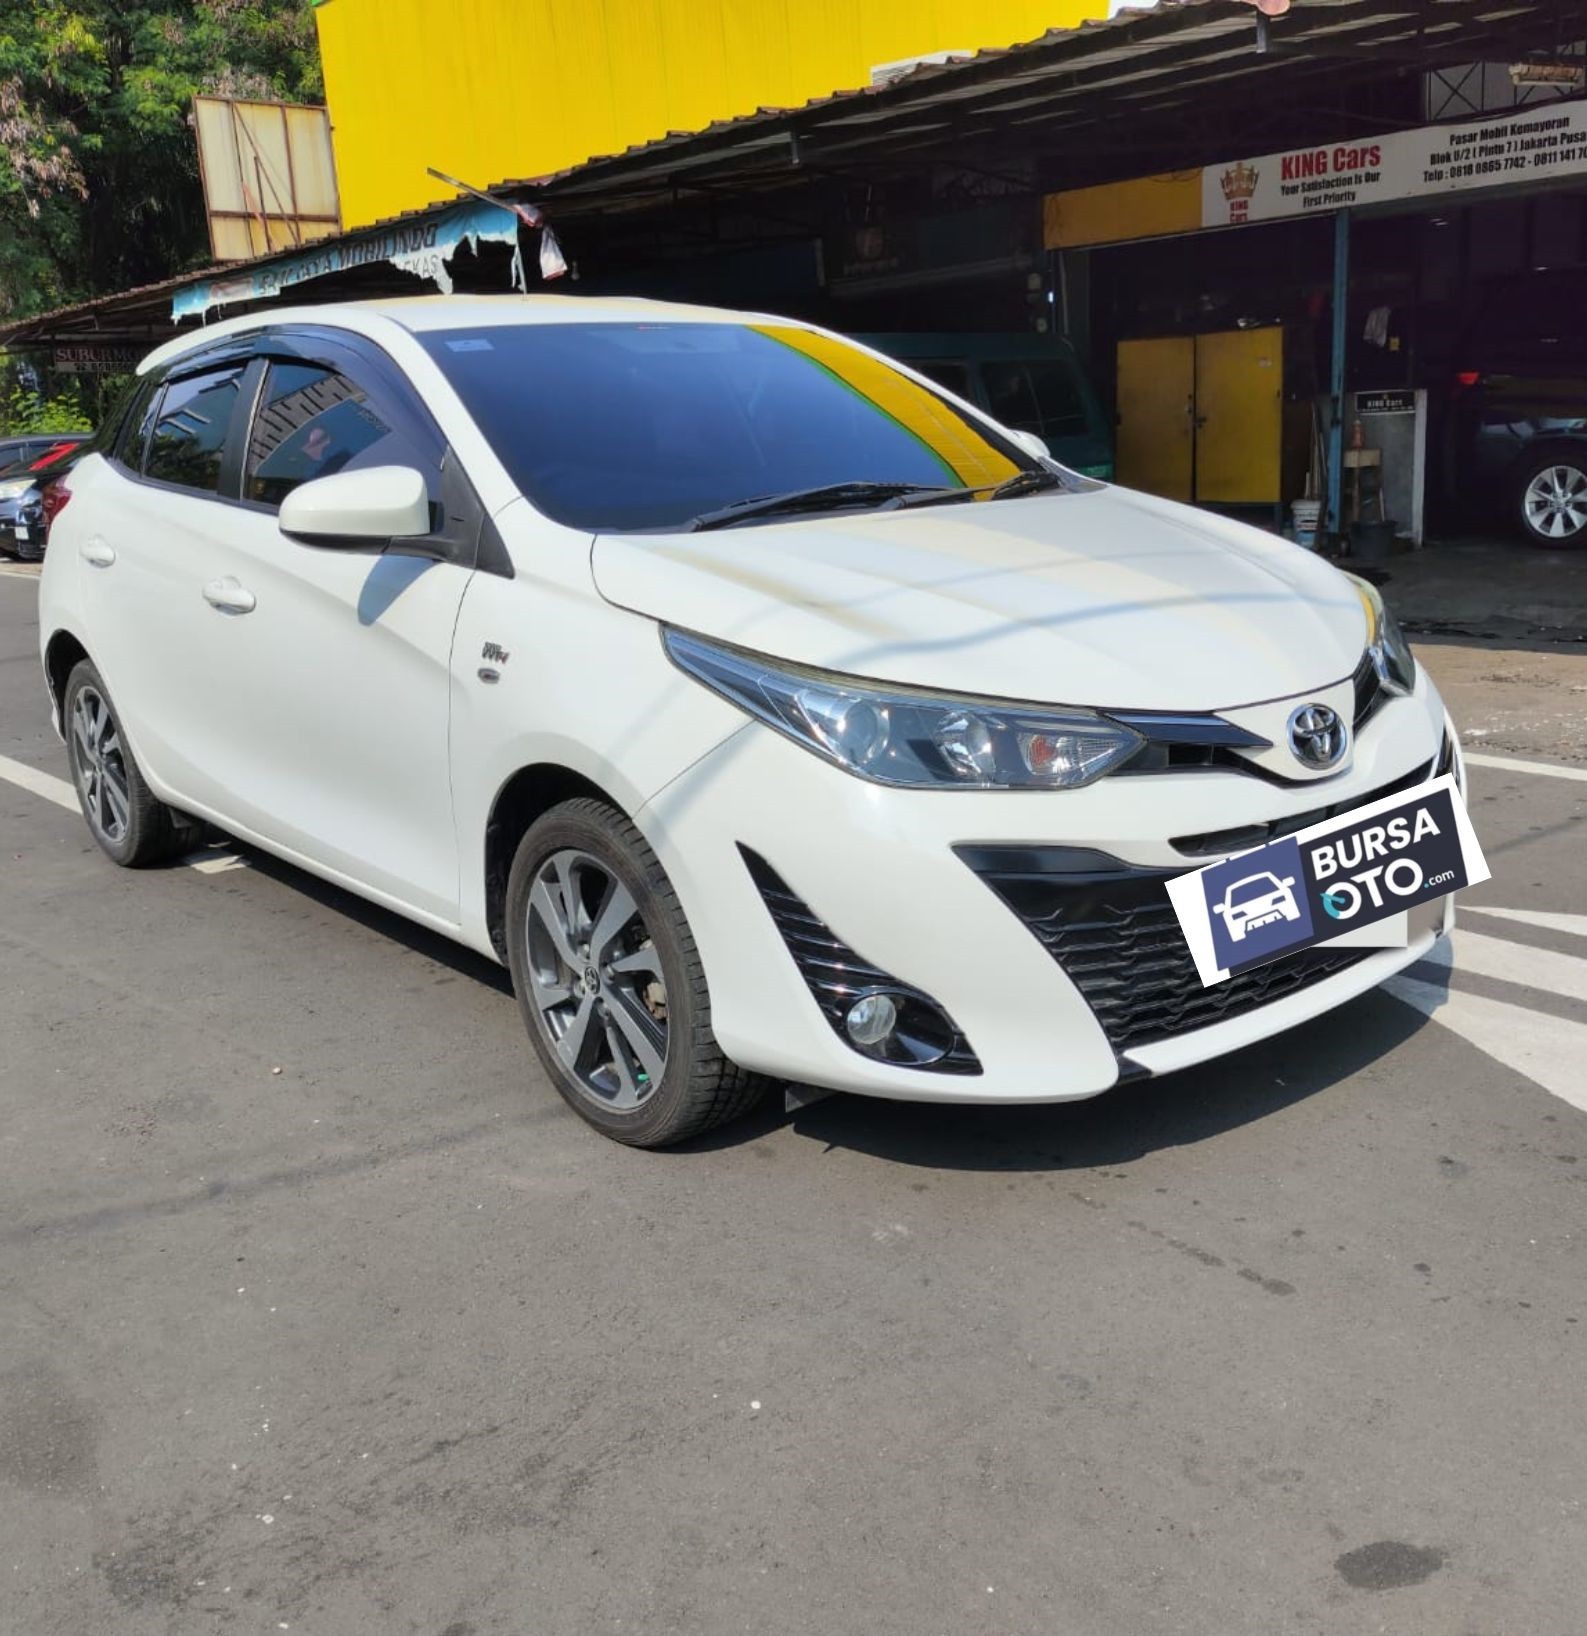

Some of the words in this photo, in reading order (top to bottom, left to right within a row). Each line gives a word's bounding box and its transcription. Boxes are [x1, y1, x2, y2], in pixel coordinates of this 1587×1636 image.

[1450, 133, 1478, 147] Pasar
[1480, 126, 1508, 142] Mobil
[1510, 117, 1570, 136] Kemayoran
[1281, 150, 1328, 181] KING
[1333, 145, 1381, 173] Cars
[1430, 153, 1451, 166] Blok
[1479, 143, 1504, 157] Pintu
[1520, 135, 1558, 152] Jakarta
[1281, 183, 1299, 196] Your
[1301, 176, 1353, 193] Satisfaction
[1354, 173, 1363, 185] Is
[1365, 171, 1381, 183] Our
[1303, 196, 1322, 208] First
[1323, 190, 1356, 205] Priority
